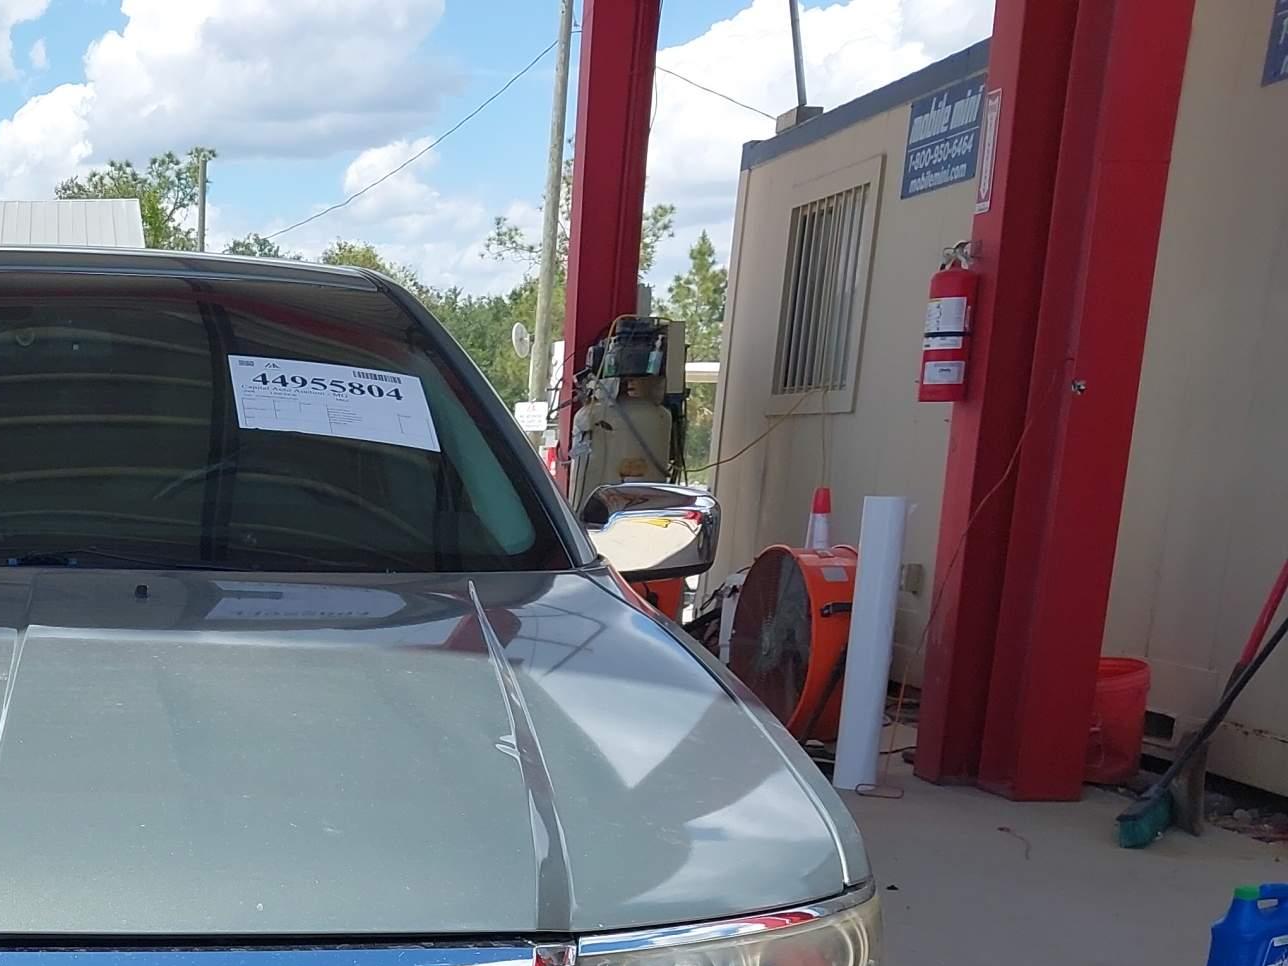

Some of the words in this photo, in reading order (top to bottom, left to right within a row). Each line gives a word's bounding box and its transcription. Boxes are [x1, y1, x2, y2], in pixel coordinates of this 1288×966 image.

[909, 92, 952, 145] mobile
[949, 85, 985, 131] mini
[908, 133, 975, 174] 1-800-950-6464
[908, 163, 968, 194] mobilemini.com
[252, 372, 404, 401] 44955804
